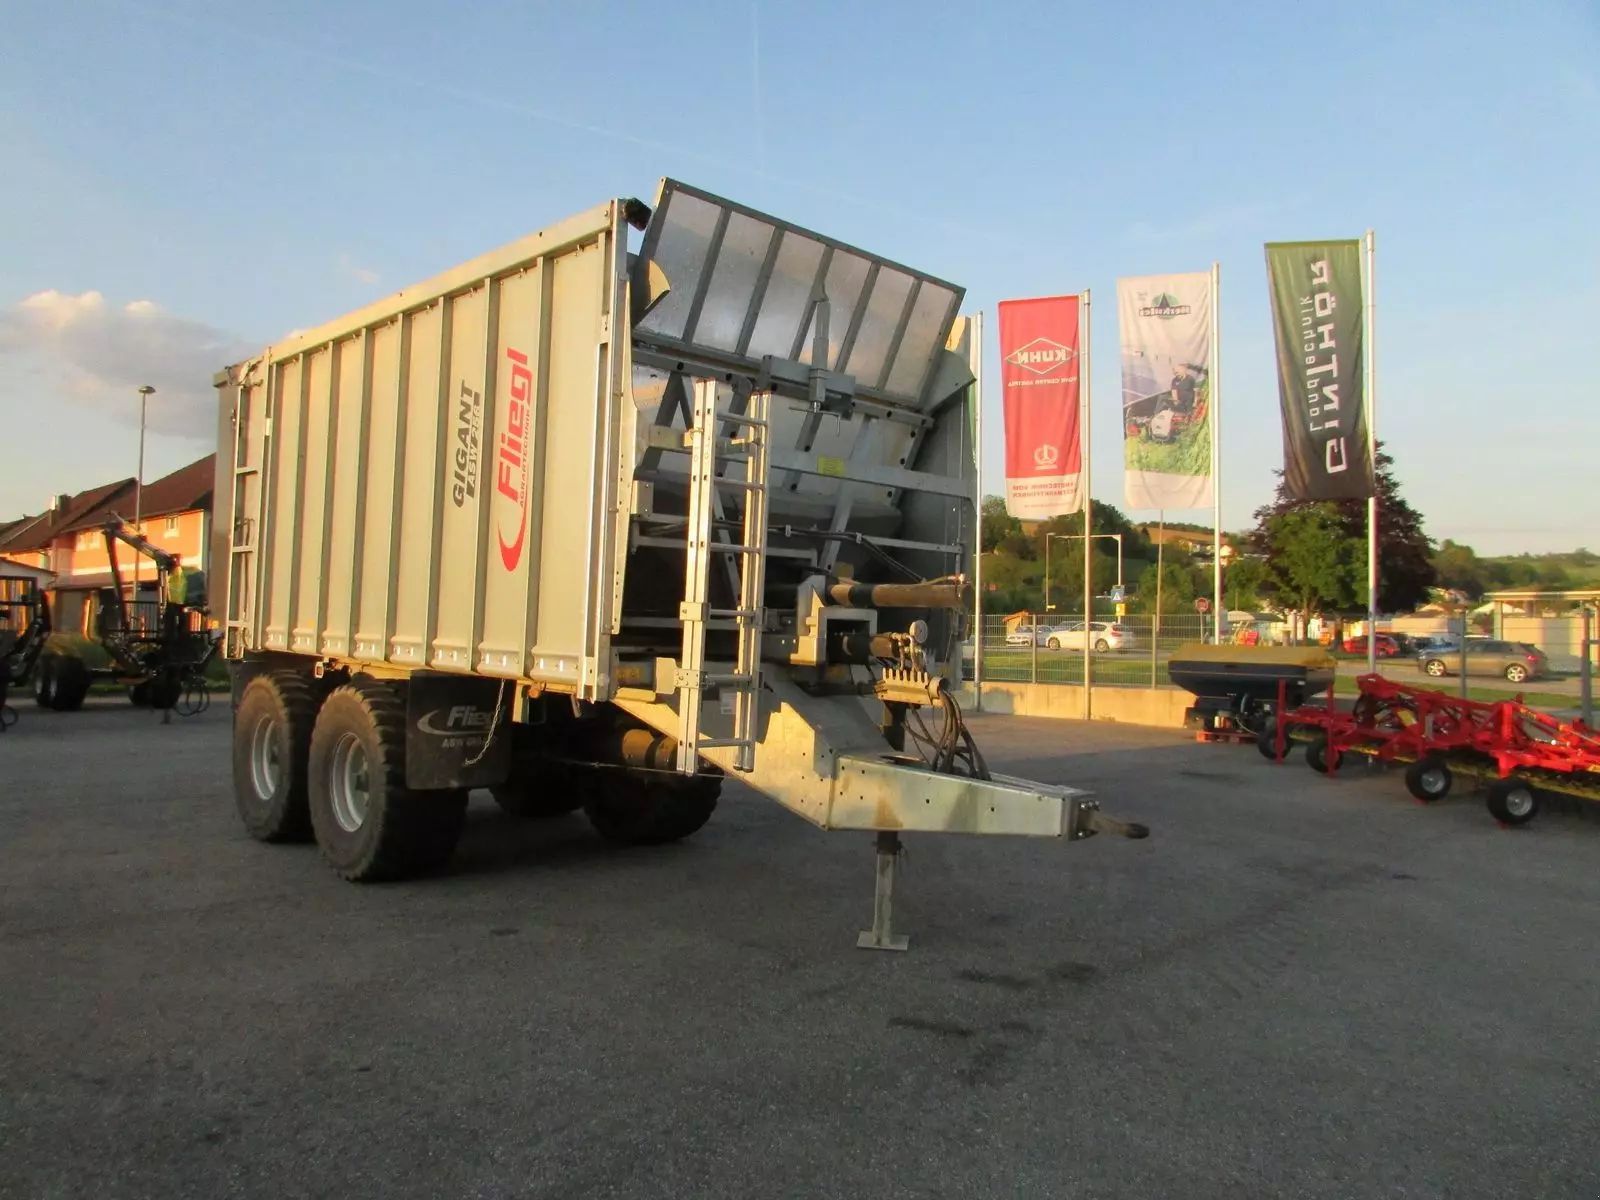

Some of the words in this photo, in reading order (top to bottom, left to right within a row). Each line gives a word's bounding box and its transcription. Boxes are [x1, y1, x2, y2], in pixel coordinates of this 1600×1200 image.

[453, 380, 473, 508] GIGANT
[467, 444, 478, 487] ASW
[497, 347, 533, 502] Fliegl
[519, 410, 531, 508] AGRARTECHNIK
